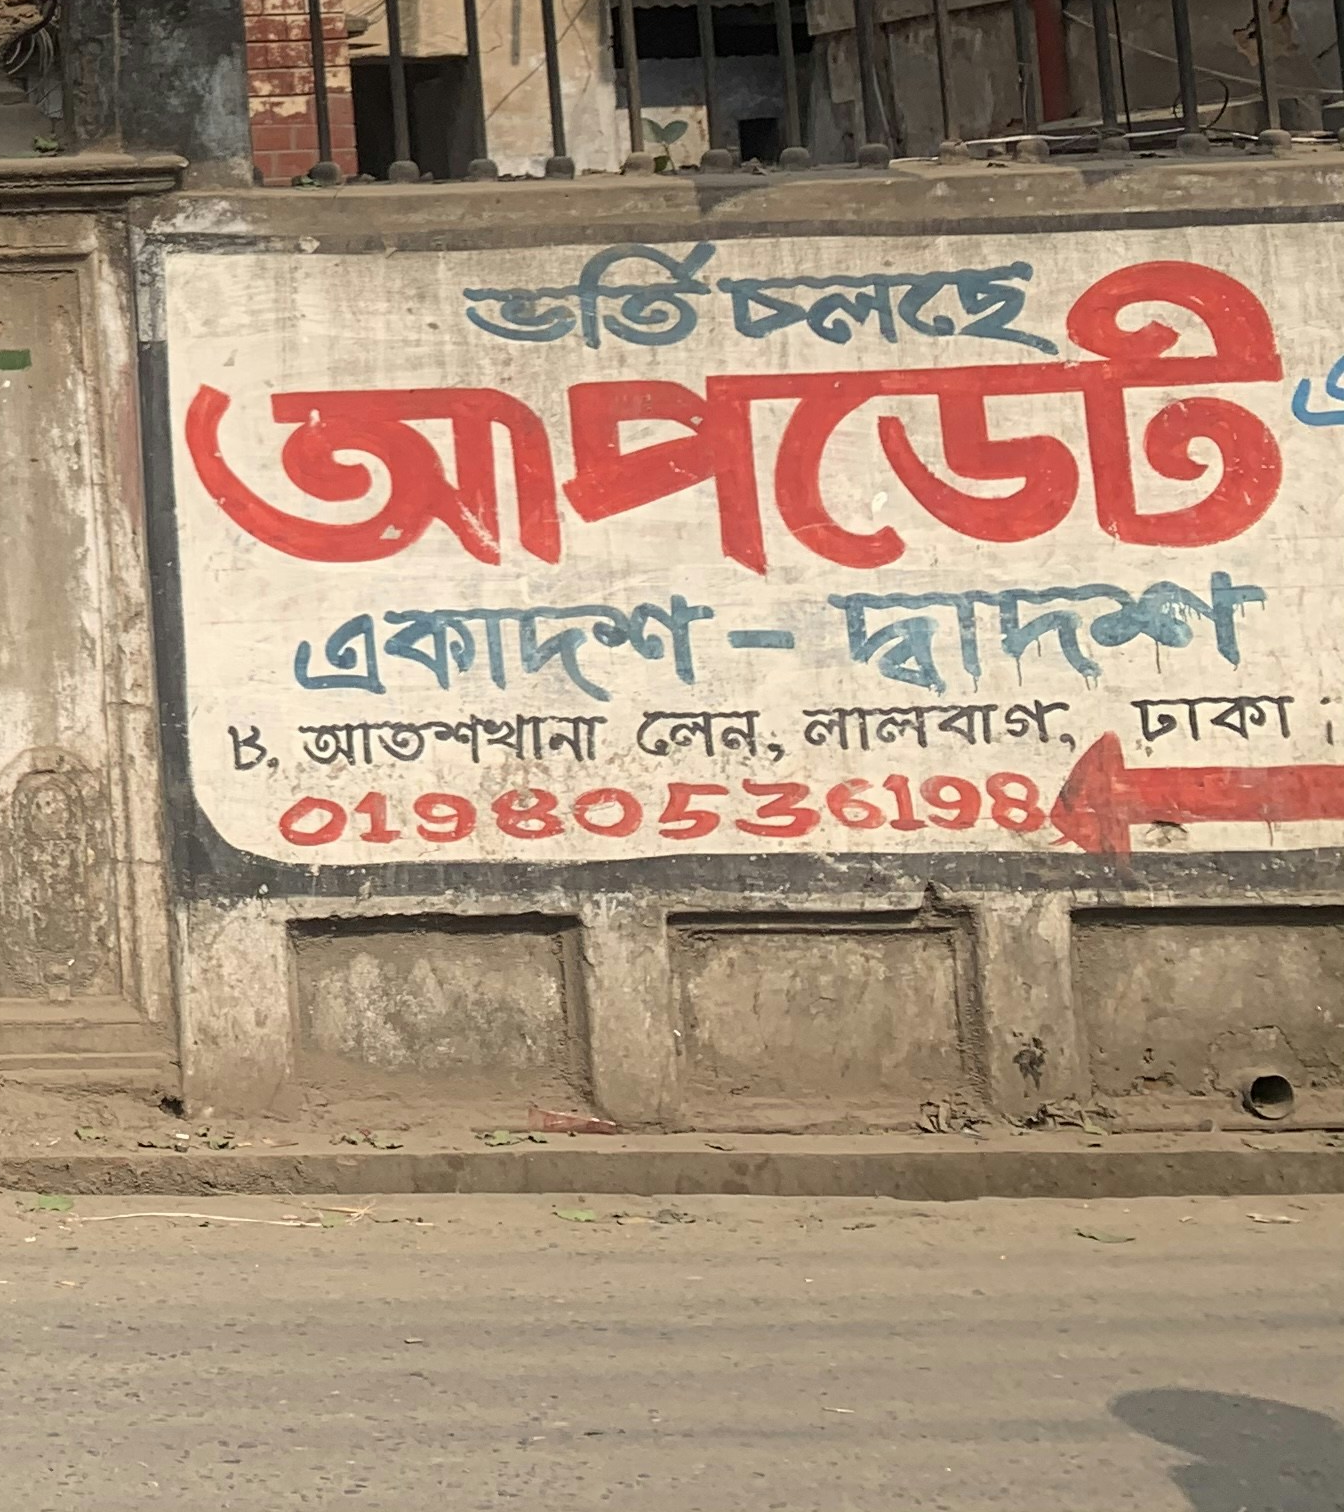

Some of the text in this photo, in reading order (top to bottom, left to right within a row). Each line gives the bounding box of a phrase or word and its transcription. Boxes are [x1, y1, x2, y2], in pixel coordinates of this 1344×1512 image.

[463, 241, 1059, 355] ভর্তি চলছে
[185, 259, 1284, 575] আপডেট
[294, 594, 714, 701] একাদশ
[828, 571, 1266, 694] দ্বাদশ
[298, 713, 609, 767] আতশখানা
[278, 772, 1046, 845] 01980536198
